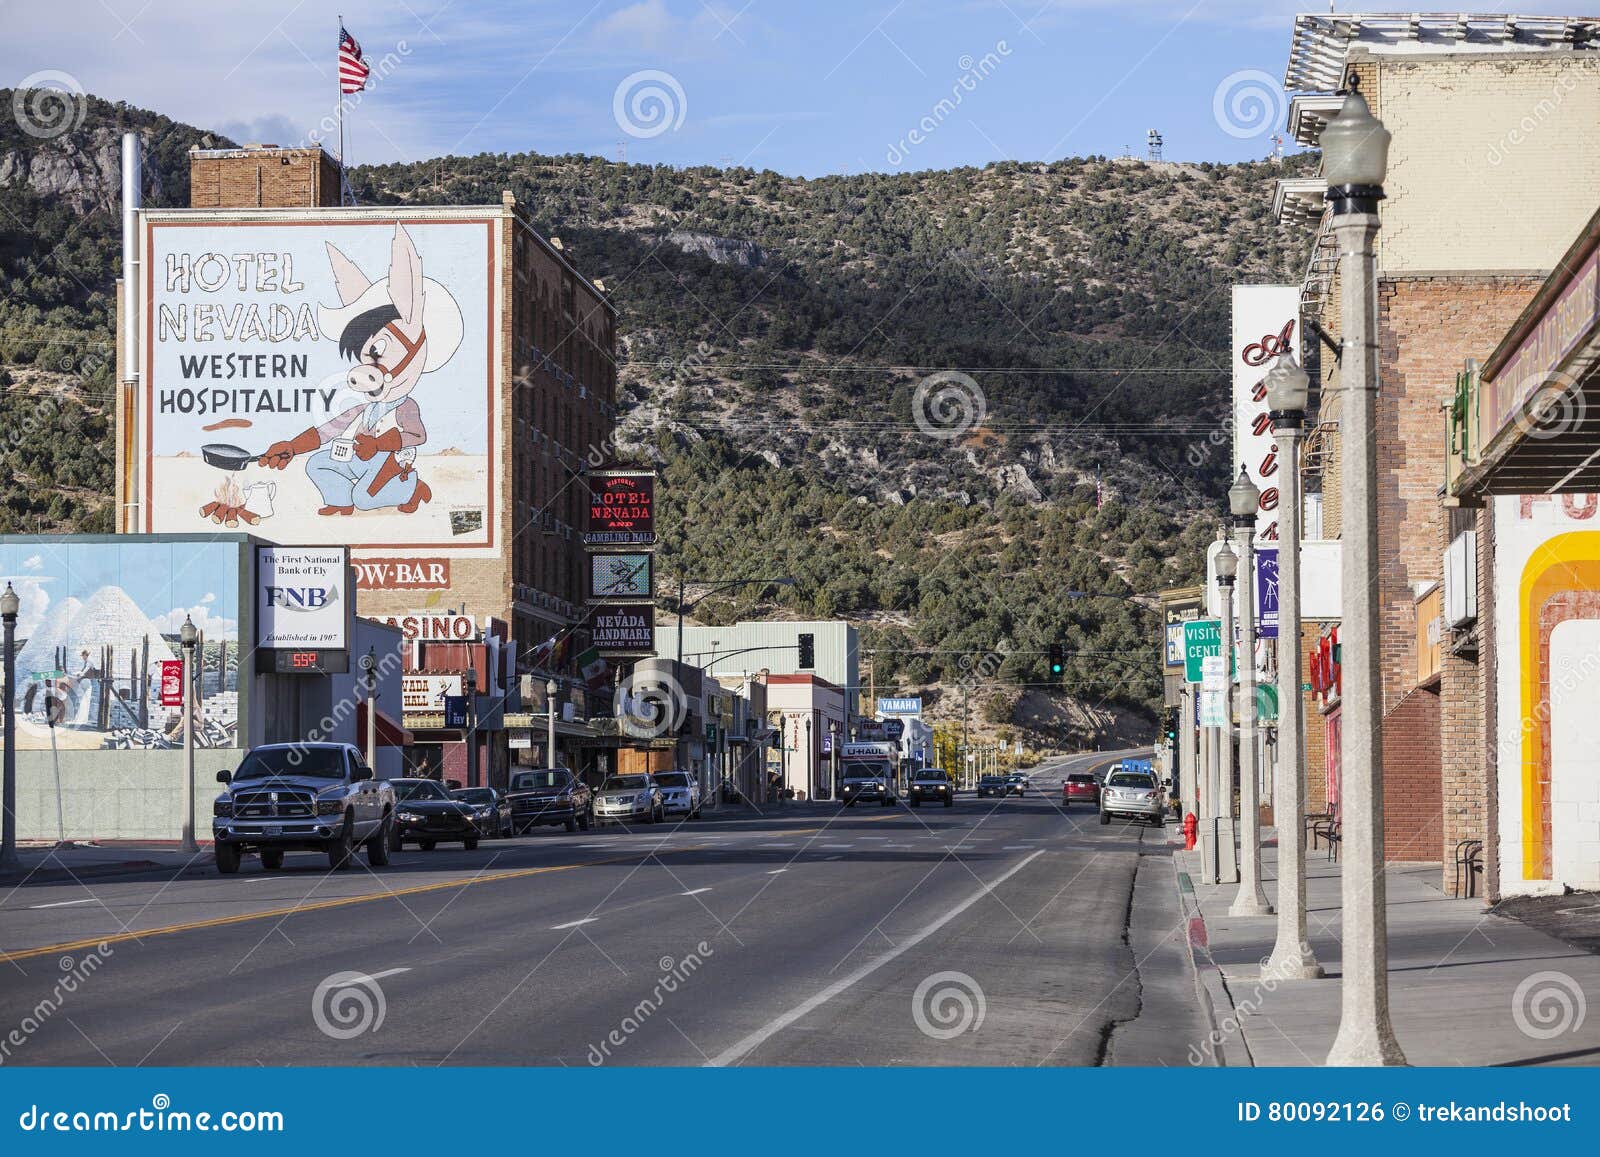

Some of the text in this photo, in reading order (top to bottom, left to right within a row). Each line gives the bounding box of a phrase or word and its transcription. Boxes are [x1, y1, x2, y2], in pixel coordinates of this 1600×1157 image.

[165, 253, 305, 294] HOTEL
[159, 302, 319, 343] NEVADA
[179, 352, 308, 379] WESTERN
[160, 387, 337, 415] HOSPITALITY
[606, 478, 636, 488] HISTORIC
[592, 492, 650, 504] HOTEL
[591, 507, 650, 519] NEVADA
[585, 533, 654, 543] GAMBLING HALL
[263, 555, 340, 564] The First National
[278, 566, 328, 576] Bank of Ely
[264, 586, 328, 607] FNB
[596, 615, 646, 627] NEVADA
[367, 616, 472, 639] SINO
[1186, 627, 1221, 640] VISIT
[266, 633, 309, 641] Established
[592, 628, 651, 640] LANDMARK
[1188, 644, 1221, 658] CENT
[403, 680, 430, 692] VADA
[404, 695, 429, 706] HALL
[882, 700, 917, 710] YAMAHA
